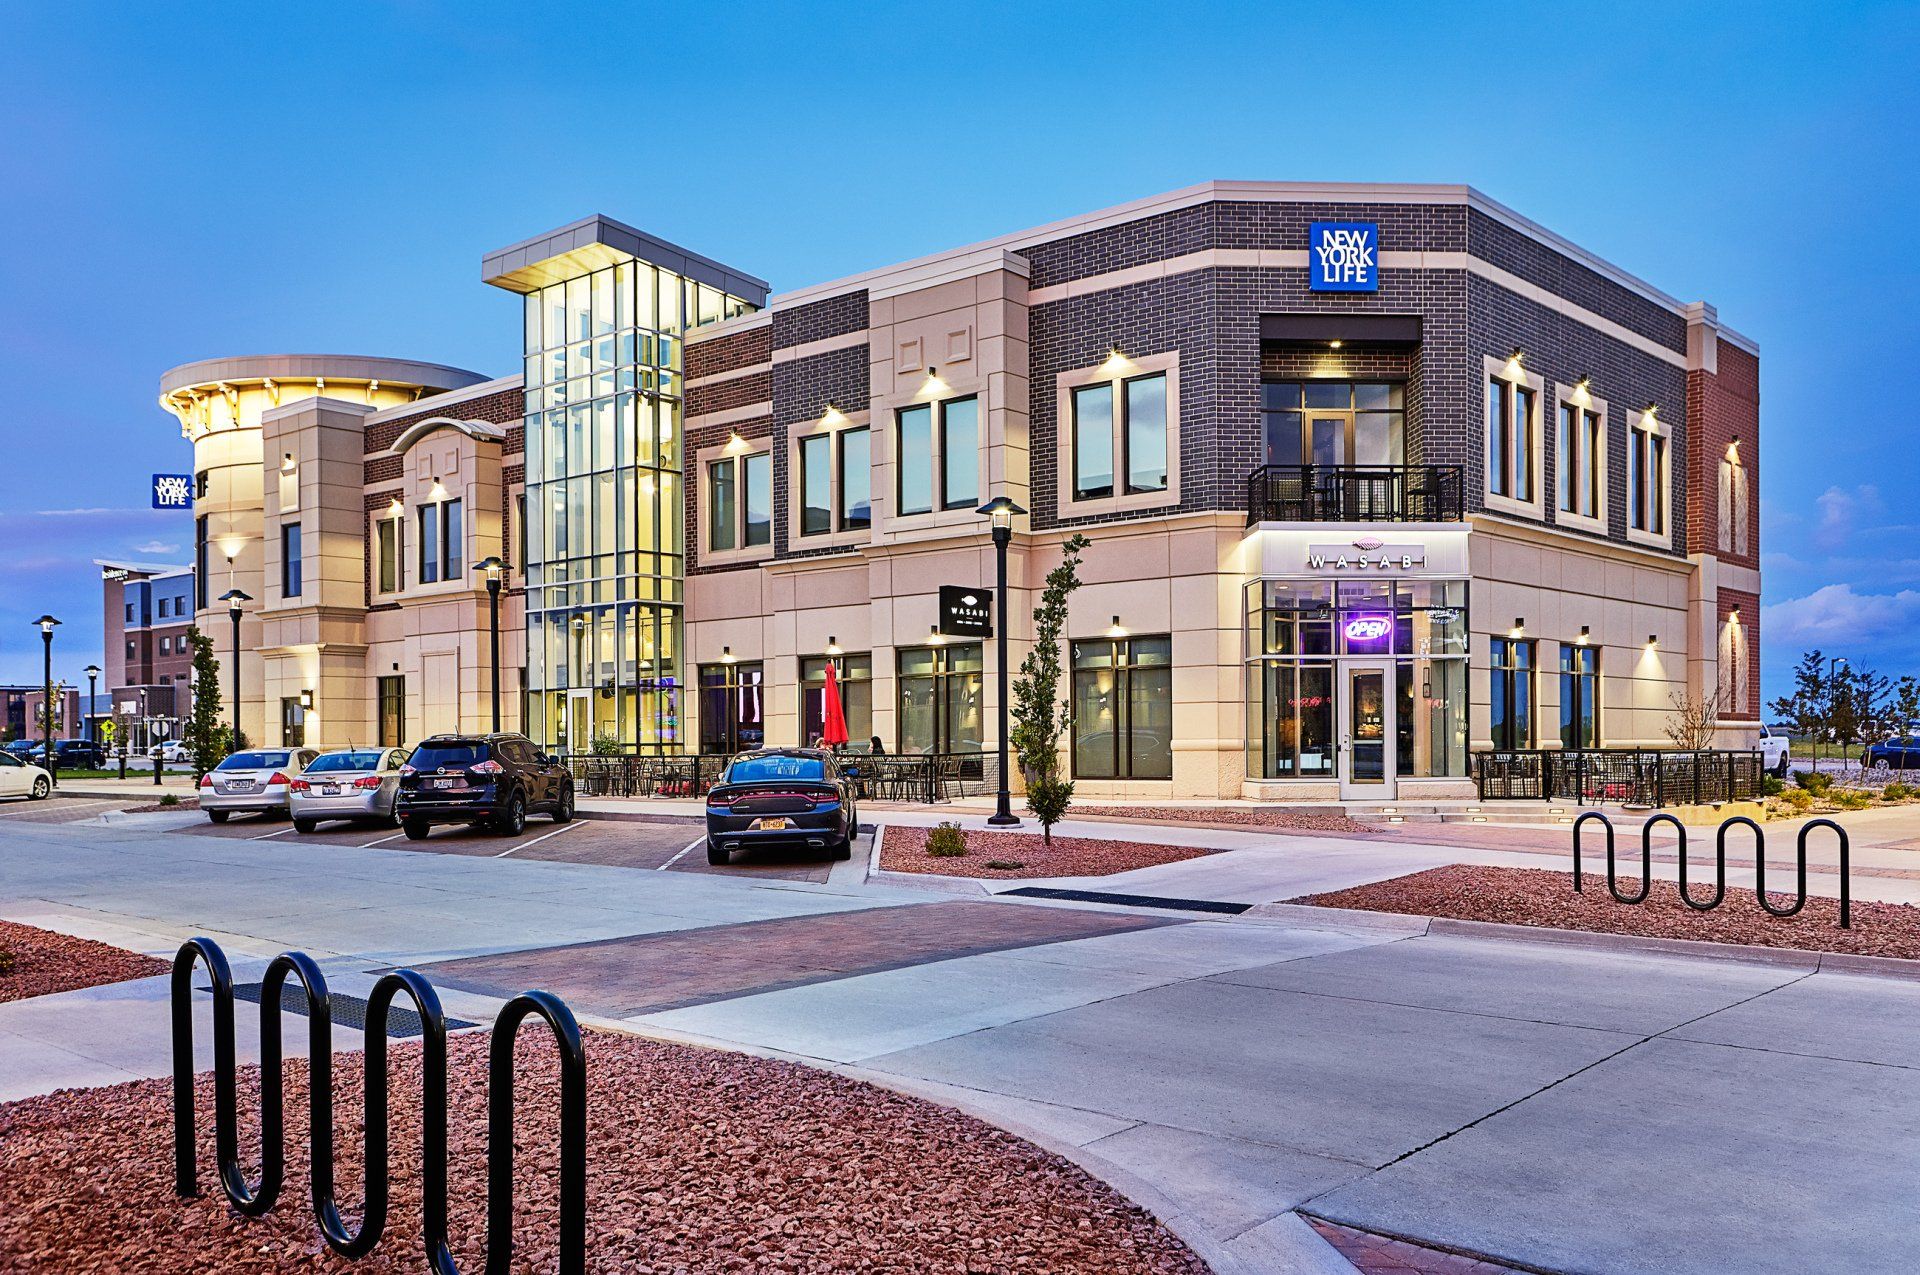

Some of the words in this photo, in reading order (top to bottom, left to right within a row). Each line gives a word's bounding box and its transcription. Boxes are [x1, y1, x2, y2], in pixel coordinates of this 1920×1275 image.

[1323, 230, 1369, 249] NEW
[1315, 246, 1374, 266] YORK
[1323, 263, 1368, 283] LIFE
[158, 477, 187, 489] NEW
[154, 485, 190, 497] YORK
[159, 495, 186, 505] LIFE
[1309, 554, 1428, 569] WASABI
[951, 607, 988, 617] WASABI
[1348, 621, 1386, 637] OPEN
